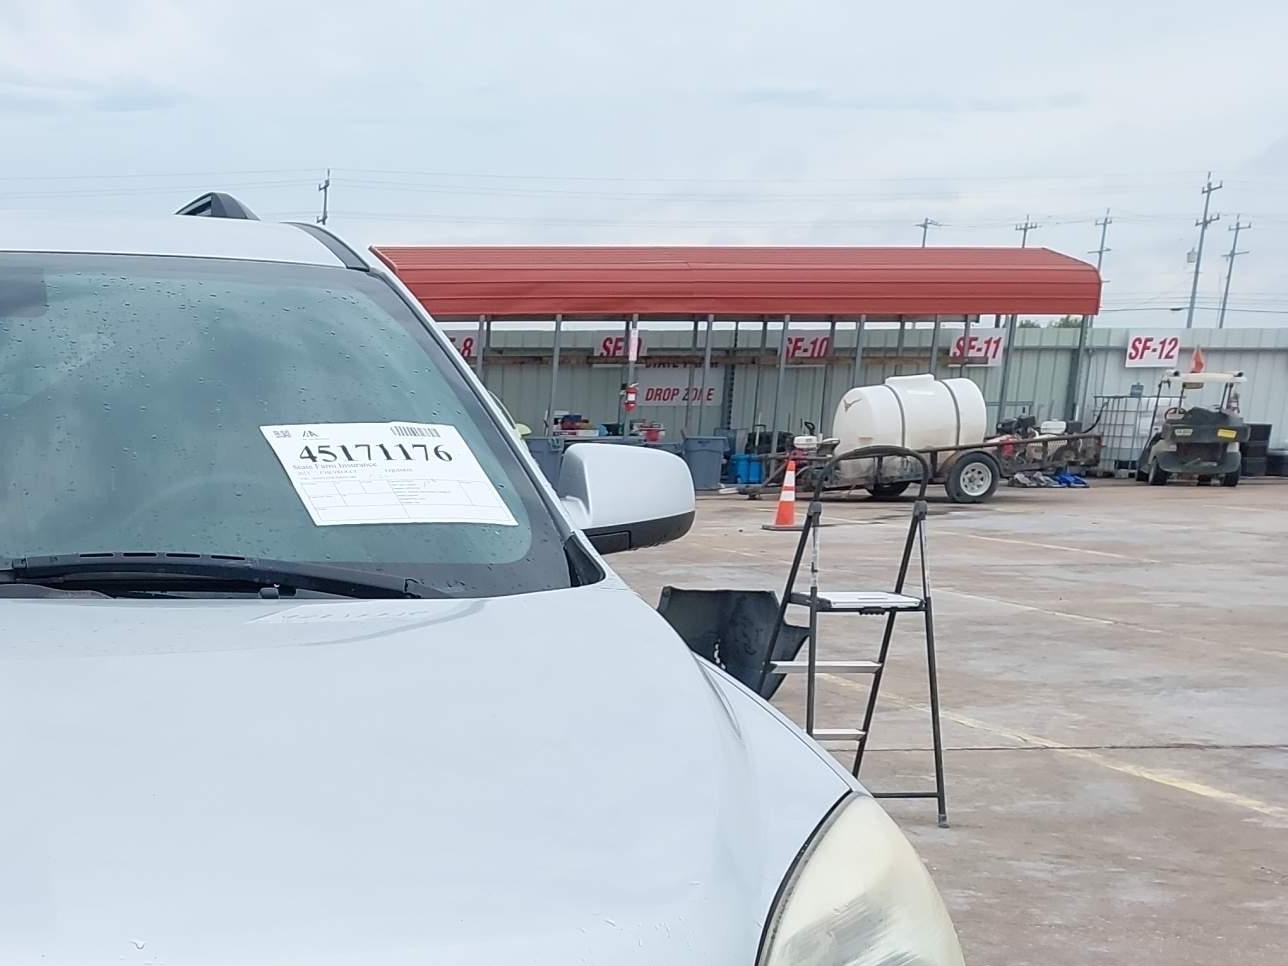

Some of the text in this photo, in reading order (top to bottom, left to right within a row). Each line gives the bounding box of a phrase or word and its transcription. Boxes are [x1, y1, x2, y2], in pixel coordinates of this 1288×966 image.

[953, 336, 1002, 360] SF-11
[1128, 337, 1179, 360] SF-12
[645, 387, 680, 401] DROP
[299, 443, 453, 463] 45171176
